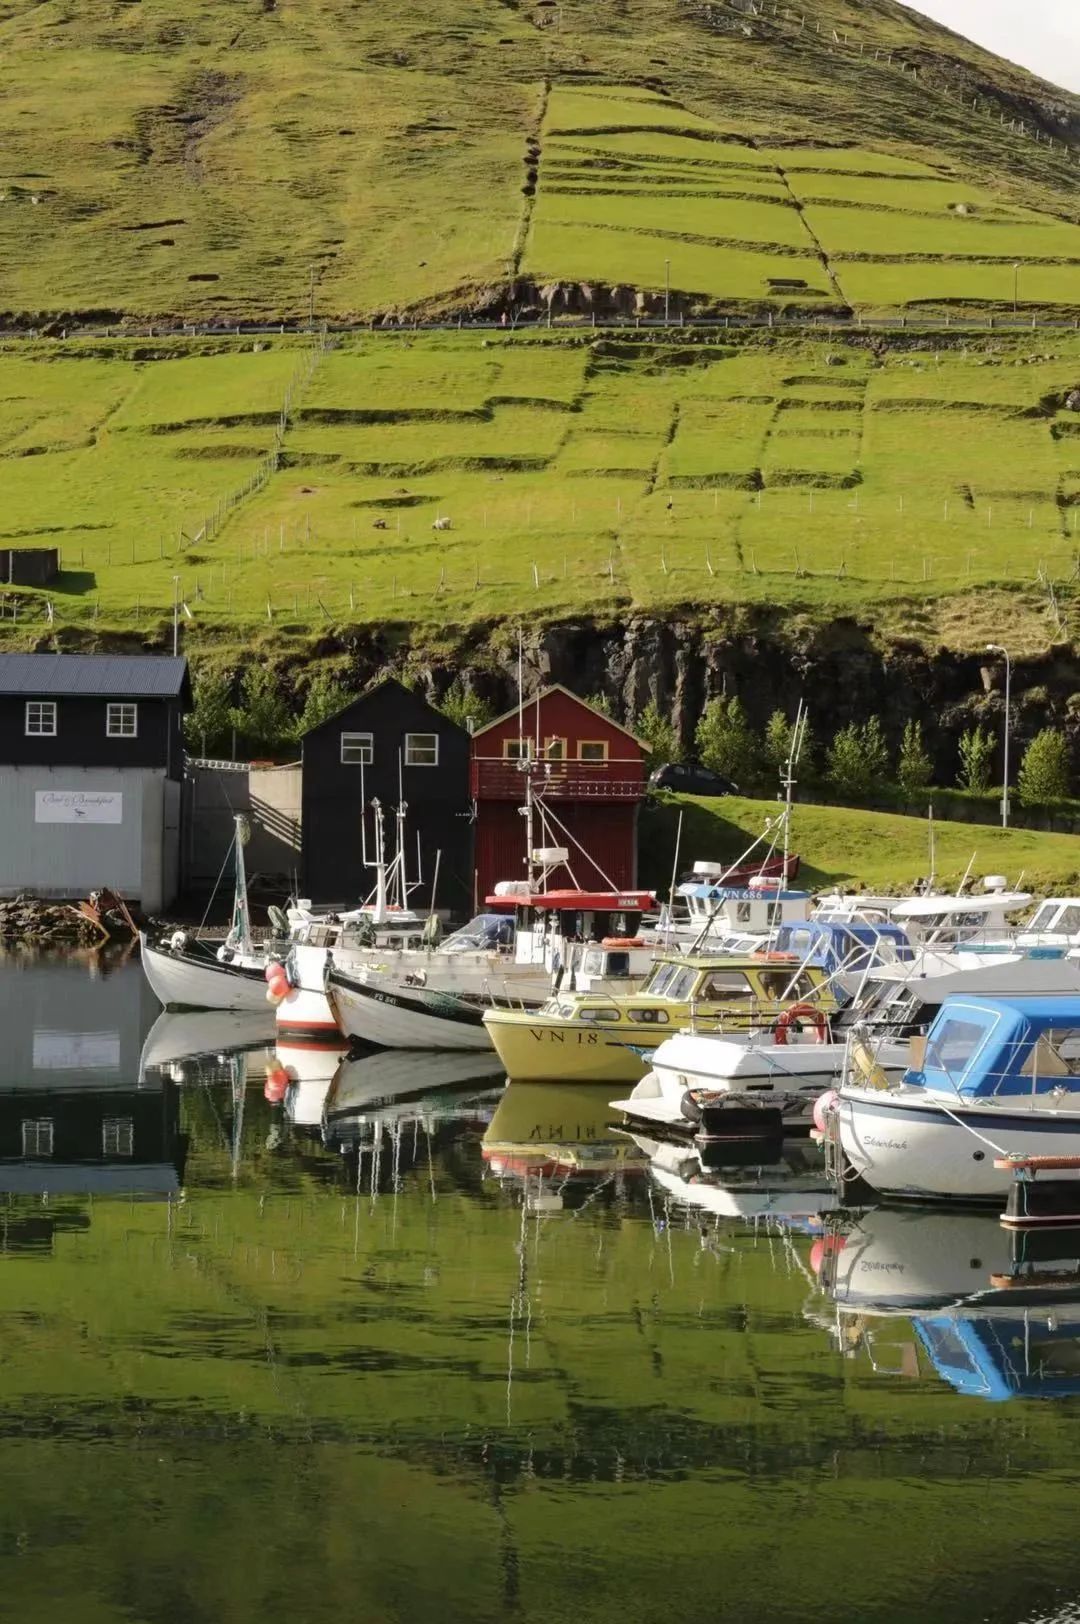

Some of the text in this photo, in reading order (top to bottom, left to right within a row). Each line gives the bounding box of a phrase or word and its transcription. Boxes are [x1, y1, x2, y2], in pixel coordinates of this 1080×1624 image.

[742, 890, 763, 899] 686
[530, 1029, 598, 1045] VN 18
